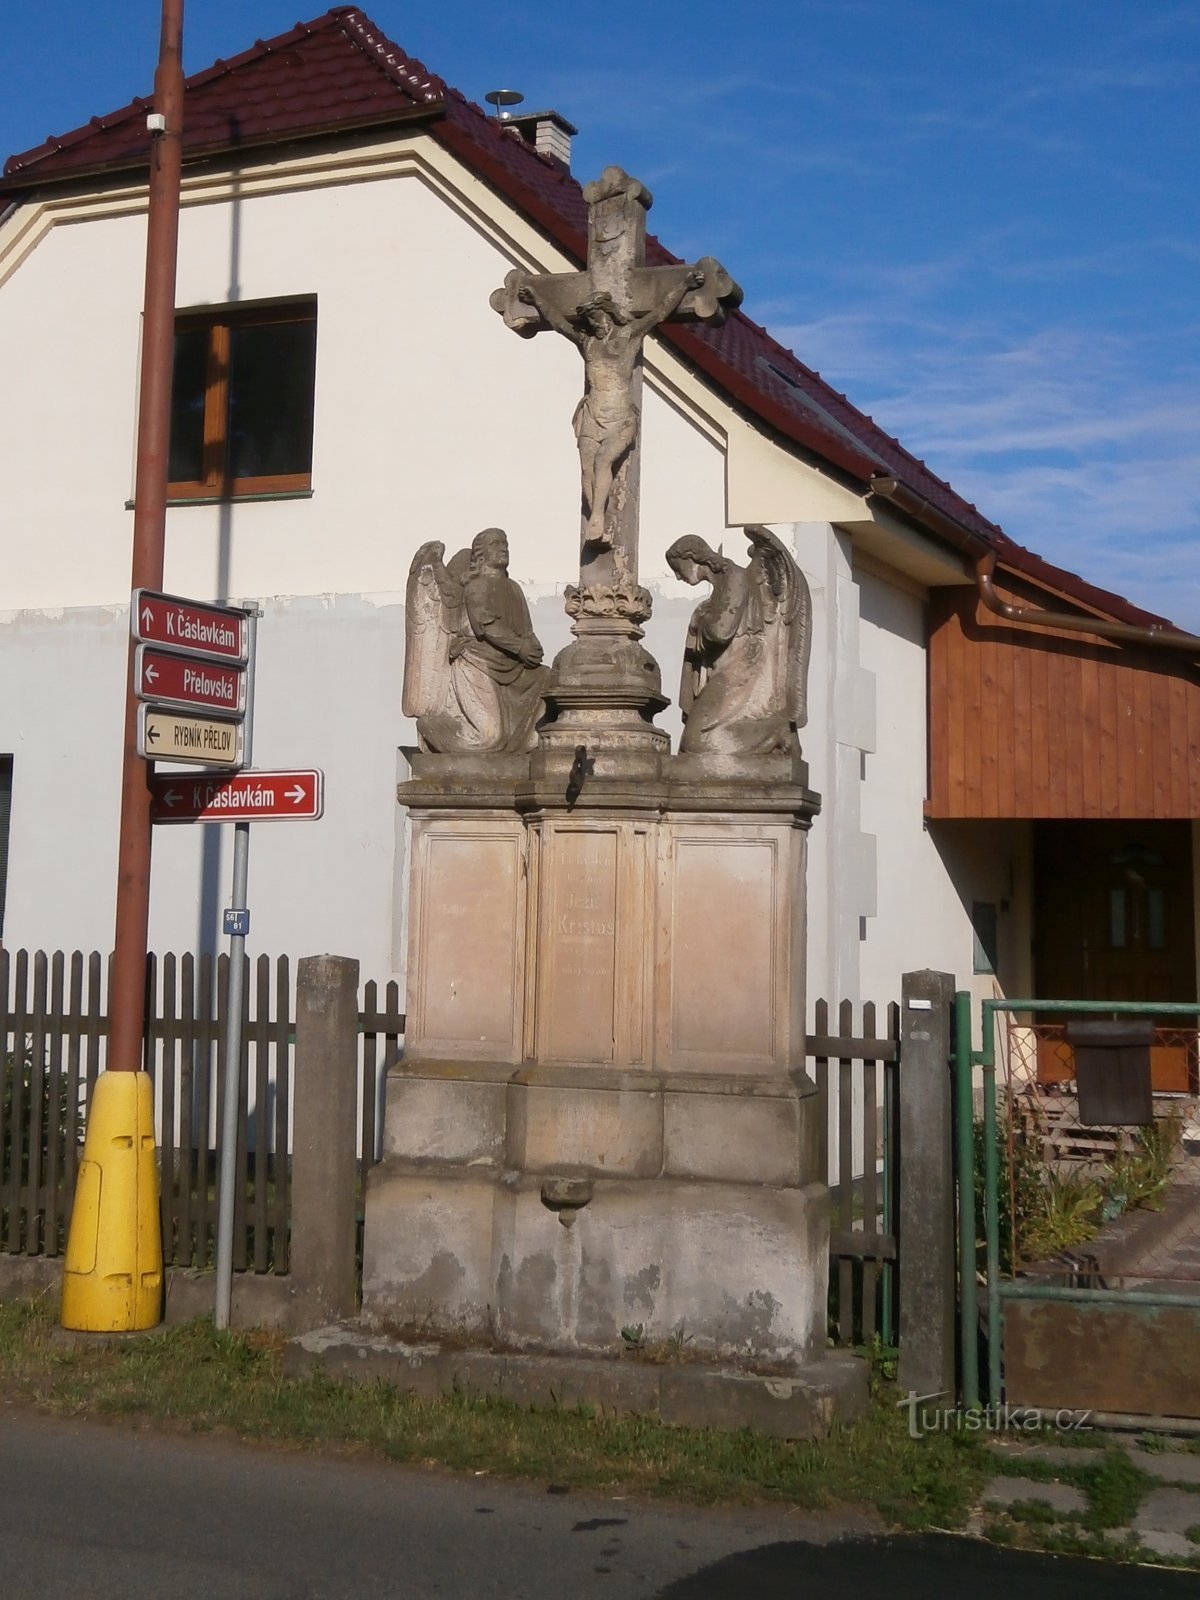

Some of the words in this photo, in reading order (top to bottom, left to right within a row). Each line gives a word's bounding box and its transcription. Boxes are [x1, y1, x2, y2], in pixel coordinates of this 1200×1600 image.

[166, 611, 174, 635] K
[178, 608, 235, 647] Čáslavkám
[183, 669, 233, 699] Přelovská
[174, 723, 201, 747] RYBNÍK
[204, 726, 231, 751] PŘELOV
[193, 787, 201, 808] K
[206, 783, 274, 808] Čáslavkám
